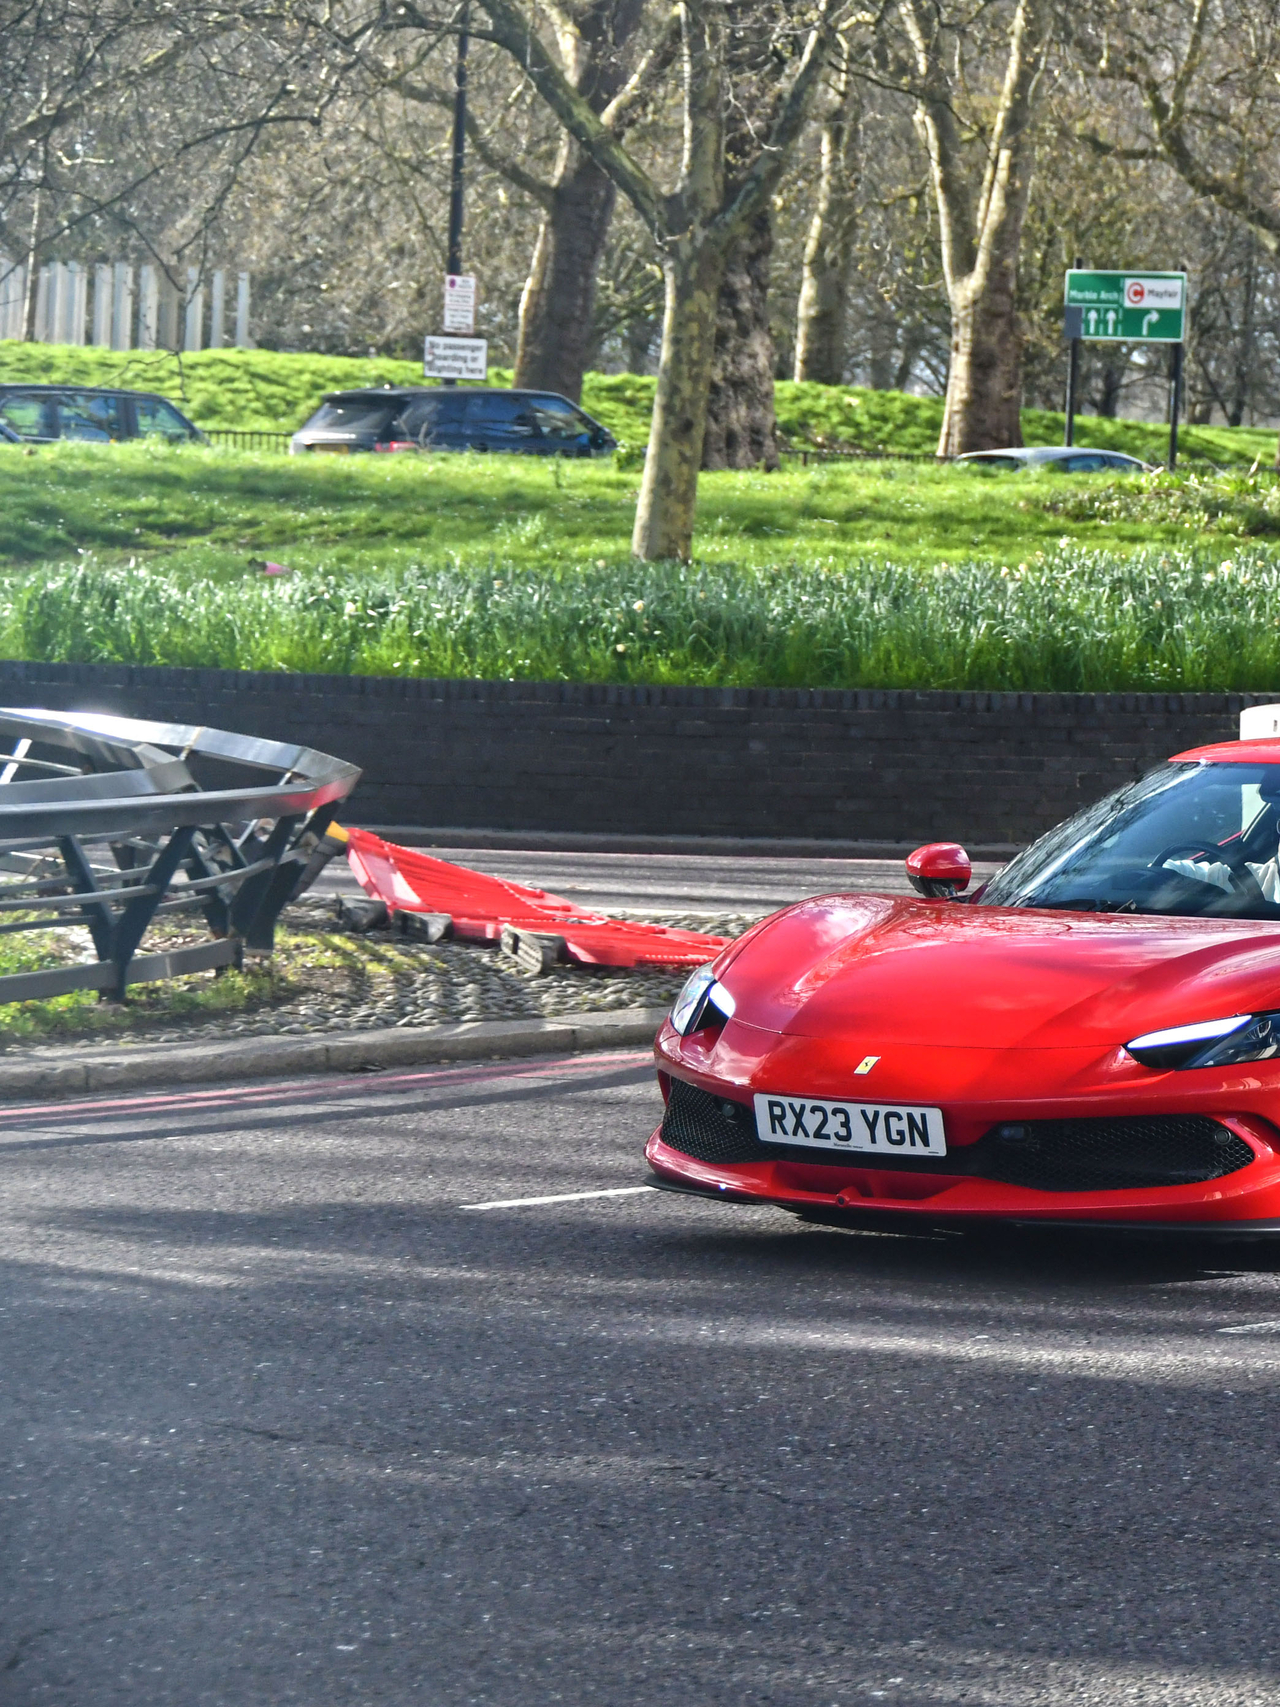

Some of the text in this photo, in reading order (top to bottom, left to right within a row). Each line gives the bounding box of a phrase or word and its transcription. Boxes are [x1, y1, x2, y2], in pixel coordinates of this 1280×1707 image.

[1069, 289, 1118, 300] Marble Arch
[1147, 288, 1178, 299] Mayfair
[431, 351, 468, 363] oarding
[767, 1100, 931, 1147] RX23 YGN
